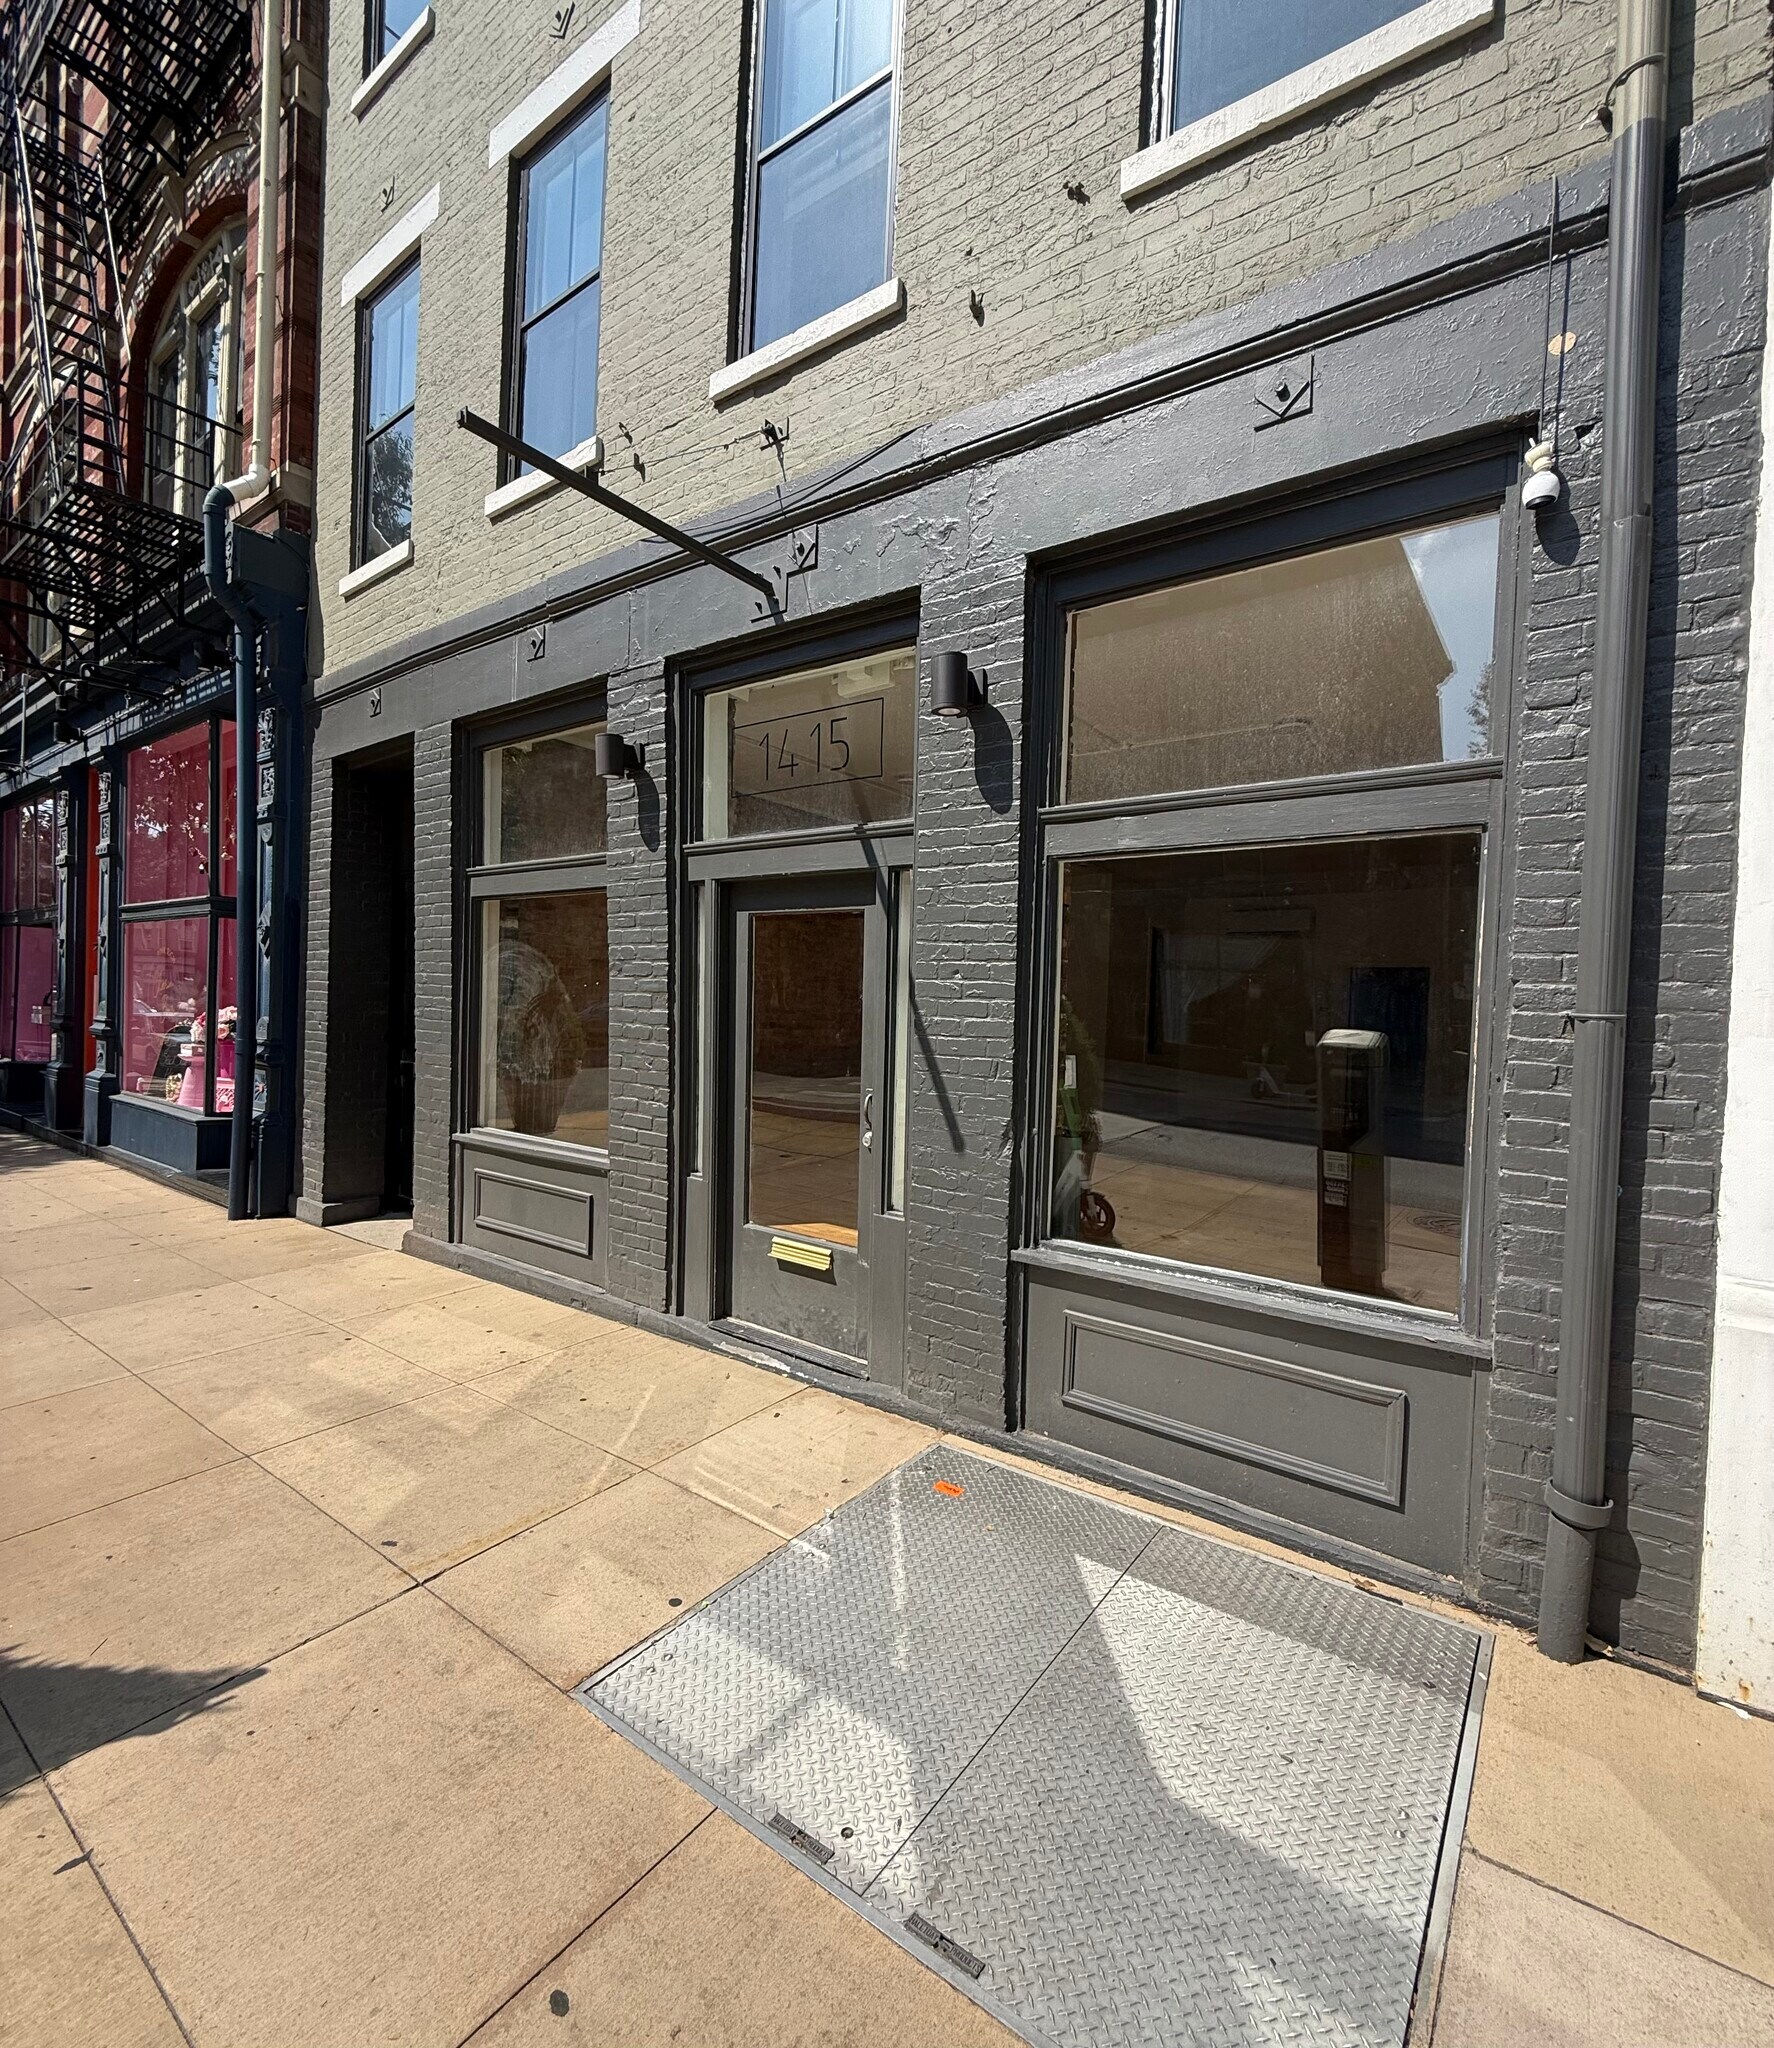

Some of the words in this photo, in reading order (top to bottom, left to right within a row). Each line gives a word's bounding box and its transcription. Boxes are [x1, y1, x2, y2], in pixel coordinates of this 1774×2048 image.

[759, 716, 850, 781] 1415
[907, 1914, 940, 1942] HALLIDAY
[948, 1945, 983, 1974] PRODUCTS
